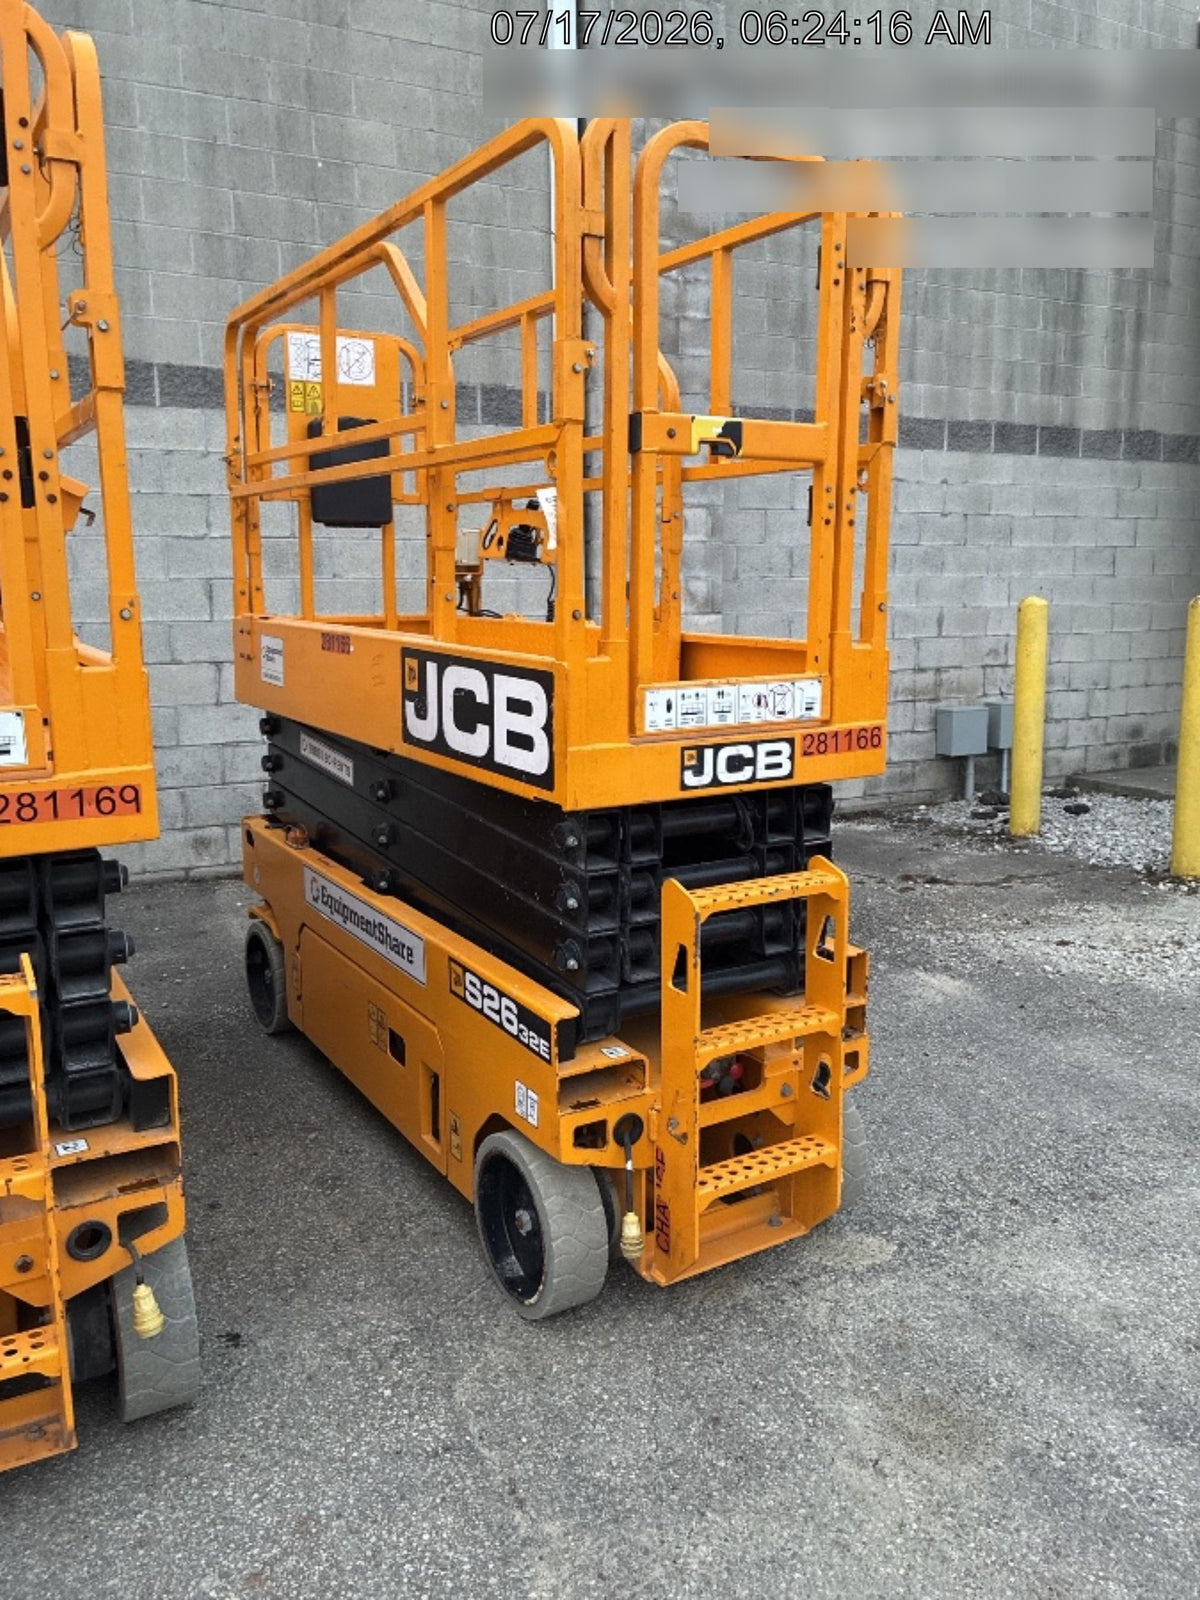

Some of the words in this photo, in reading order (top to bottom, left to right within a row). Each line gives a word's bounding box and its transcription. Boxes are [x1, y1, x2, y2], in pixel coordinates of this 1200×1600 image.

[405, 661, 549, 775] JCB
[803, 726, 882, 756] 281166
[683, 741, 792, 787] JCB
[321, 885, 415, 965] EquipmentShare
